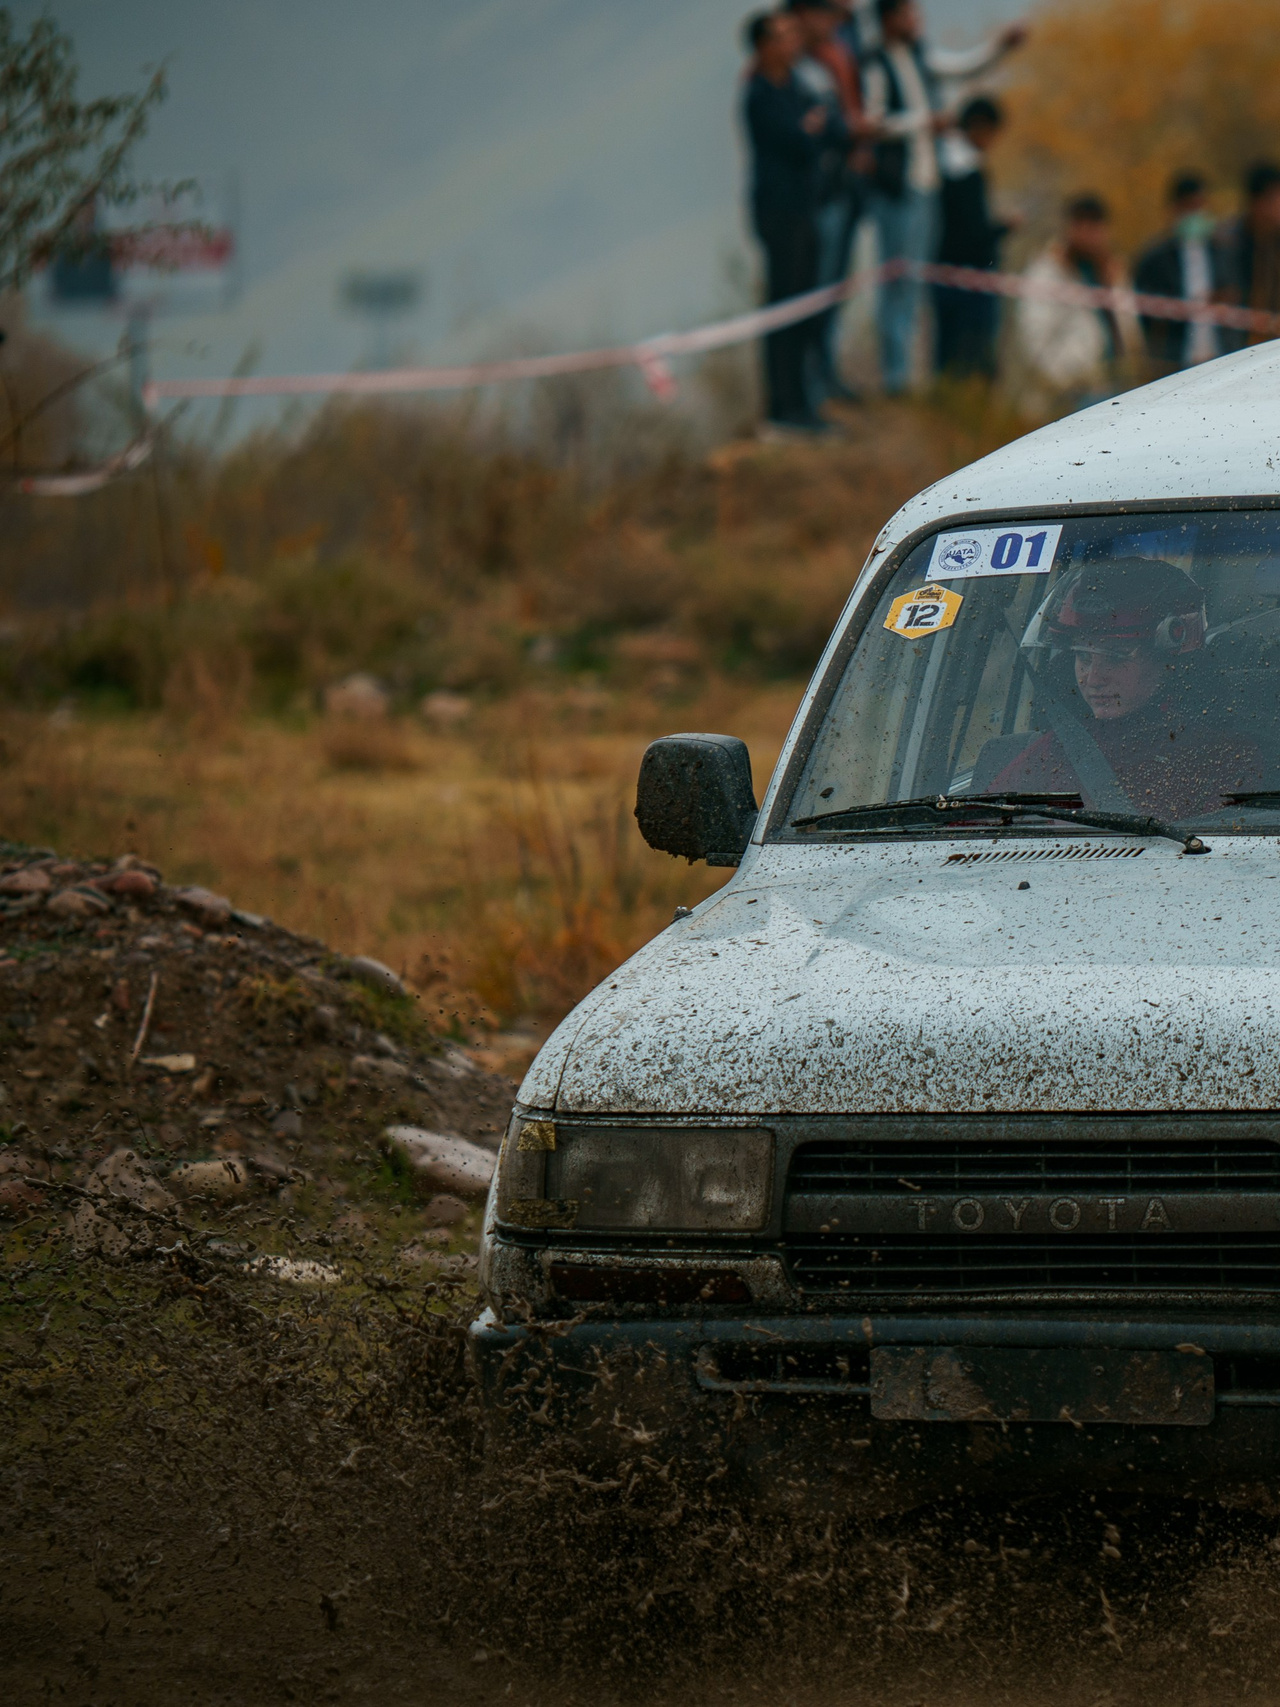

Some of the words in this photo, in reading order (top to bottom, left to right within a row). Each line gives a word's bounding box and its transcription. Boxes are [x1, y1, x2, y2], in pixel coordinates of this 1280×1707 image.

[990, 531, 1048, 569] 01
[906, 604, 940, 627] 12
[908, 1197, 1175, 1232] TOYOTA
